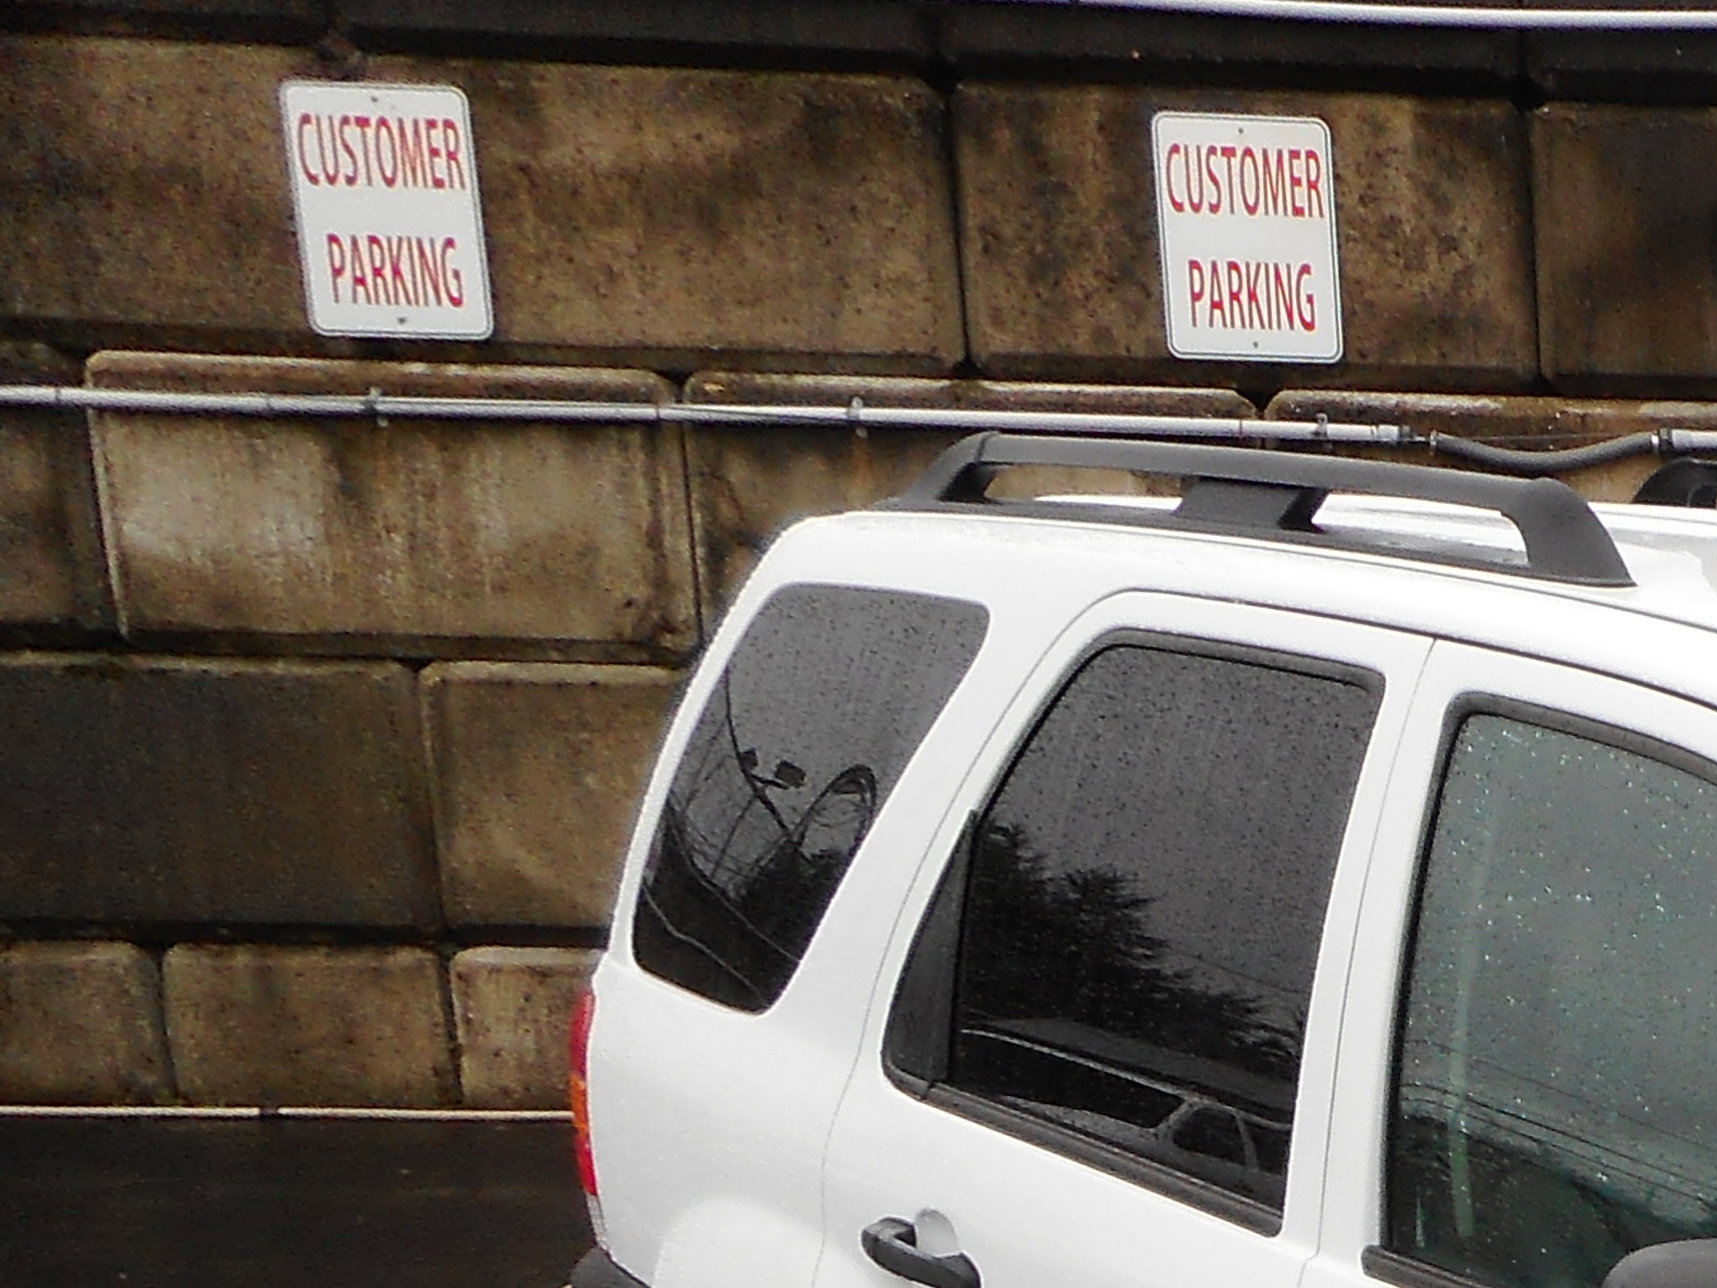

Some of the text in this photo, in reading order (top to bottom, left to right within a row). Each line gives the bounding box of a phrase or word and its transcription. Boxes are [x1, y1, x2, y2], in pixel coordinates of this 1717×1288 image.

[297, 112, 466, 191] CUSTOMER
[1167, 143, 1325, 220] CUSTOMER
[326, 233, 465, 309] PARKING
[1187, 258, 1320, 334] PARKING
